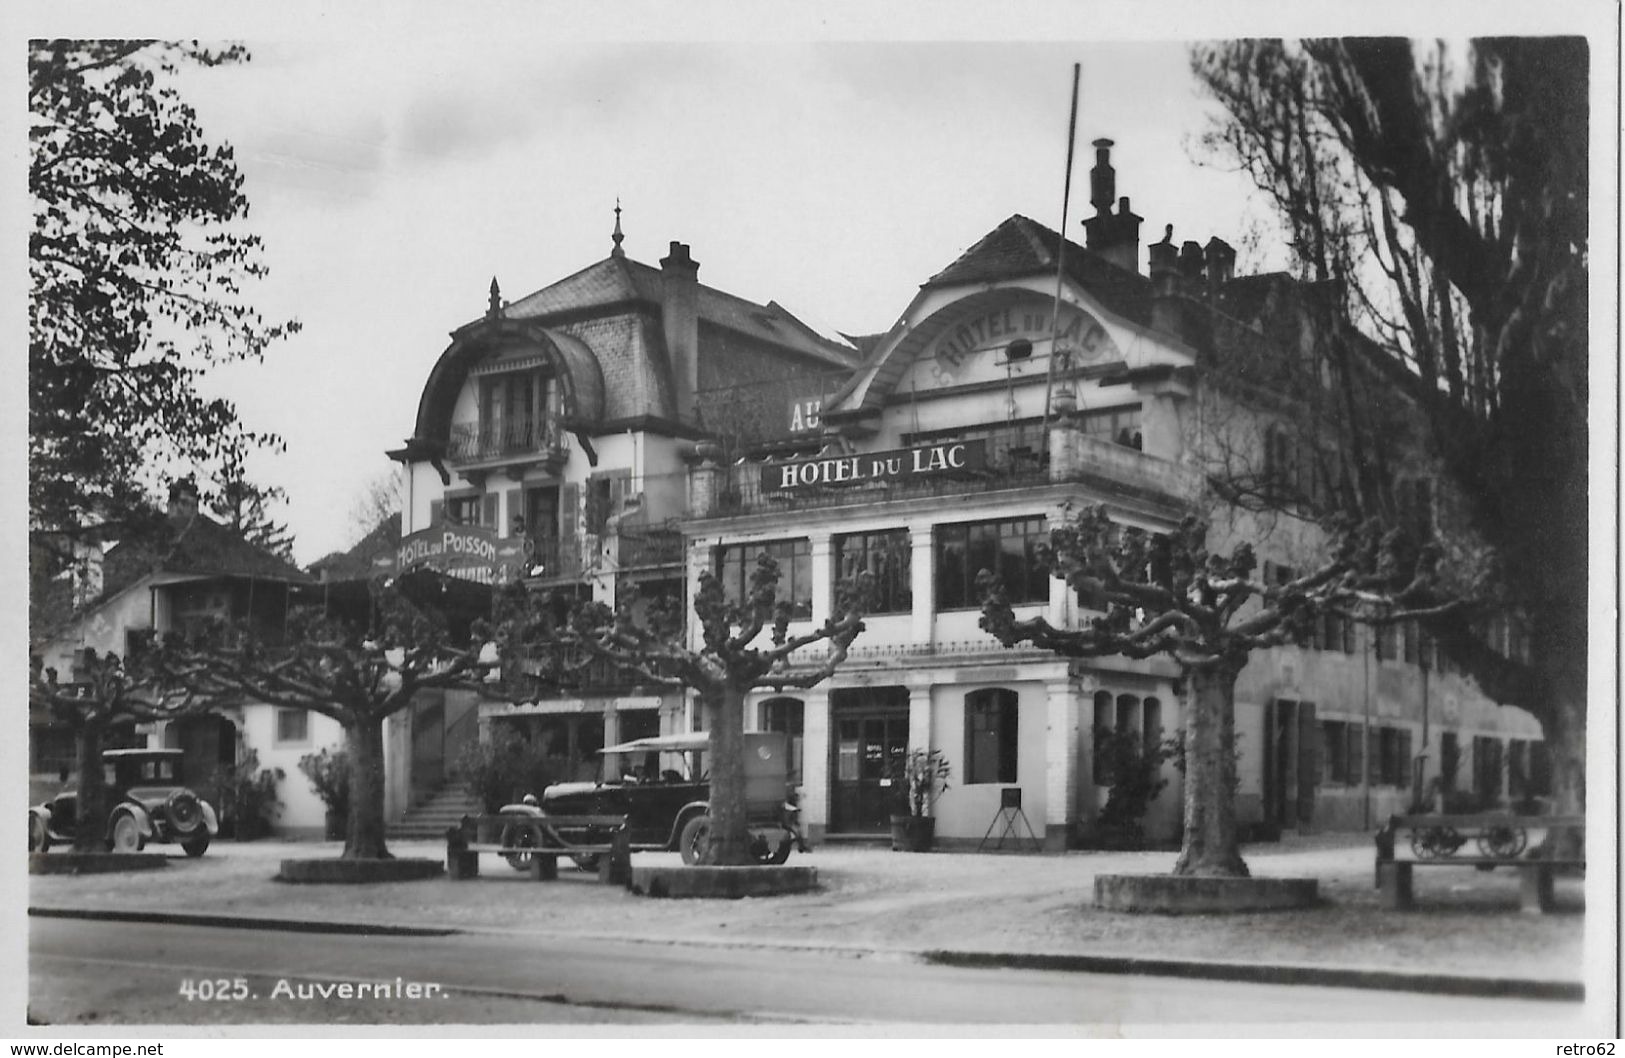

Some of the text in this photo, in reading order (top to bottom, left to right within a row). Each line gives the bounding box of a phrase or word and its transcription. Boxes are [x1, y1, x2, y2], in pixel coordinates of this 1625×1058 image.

[1024, 313, 1045, 332] DU
[790, 400, 820, 431] AU
[780, 445, 965, 488] HOTEL DU LAC
[442, 531, 496, 563] POISSON
